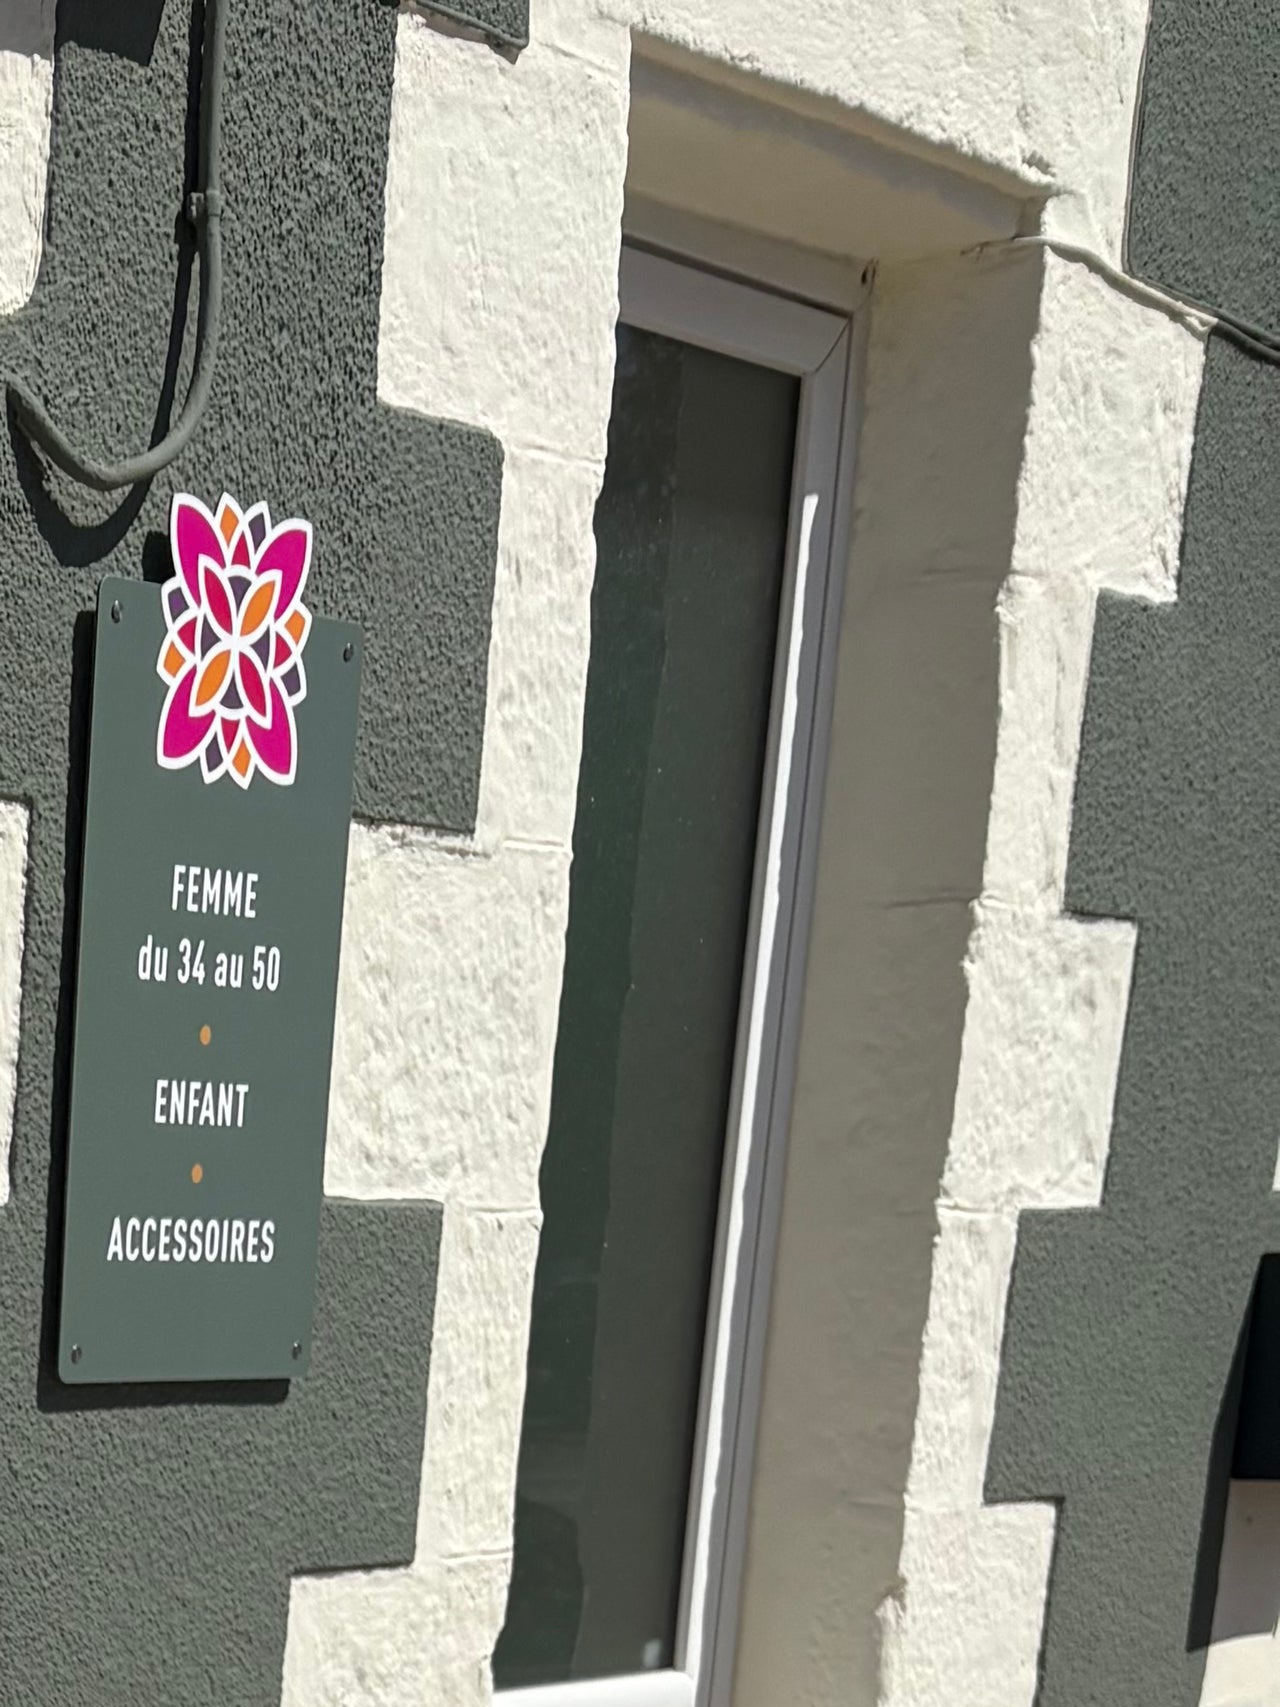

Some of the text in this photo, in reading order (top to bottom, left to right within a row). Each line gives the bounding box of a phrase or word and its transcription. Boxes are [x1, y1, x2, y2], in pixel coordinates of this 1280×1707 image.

[171, 864, 259, 919] FEMME
[138, 934, 281, 992] du 34 au 50
[154, 1079, 249, 1128] ENFANT
[106, 1215, 276, 1263] ACCESSOIRES
